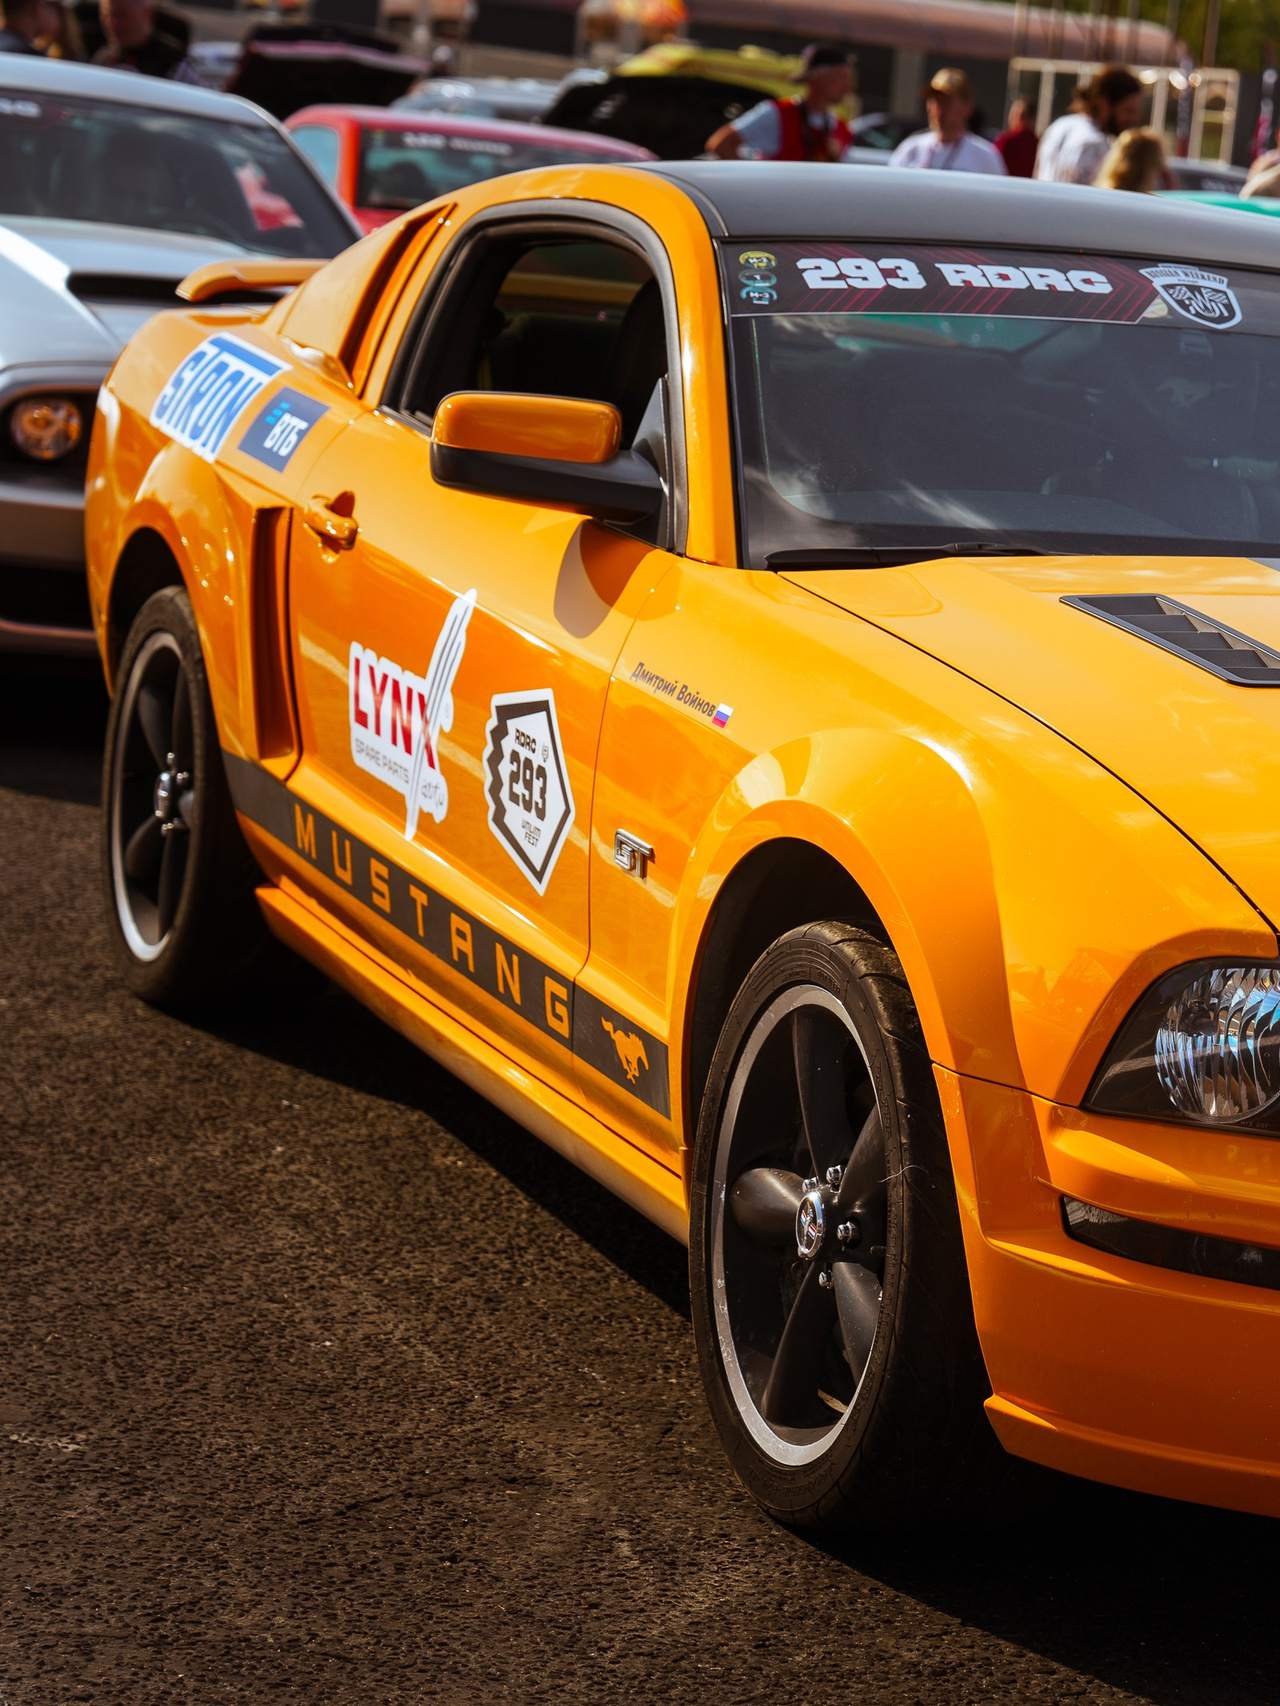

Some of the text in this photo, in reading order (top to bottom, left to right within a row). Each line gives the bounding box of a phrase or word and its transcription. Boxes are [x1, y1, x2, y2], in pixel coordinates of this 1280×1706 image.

[795, 258, 1113, 294] 293 RDRC
[155, 336, 282, 454] STRON
[263, 412, 309, 457] ВТБ
[354, 657, 436, 771] LYNX
[630, 661, 716, 718] Дмитрий Войнов
[354, 737, 410, 785] SPARE PARTS
[514, 727, 537, 754] RDRC
[509, 748, 548, 823] 293
[524, 831, 539, 847] FEST
[614, 828, 654, 878] GT
[294, 803, 570, 1039] MUSTANG
